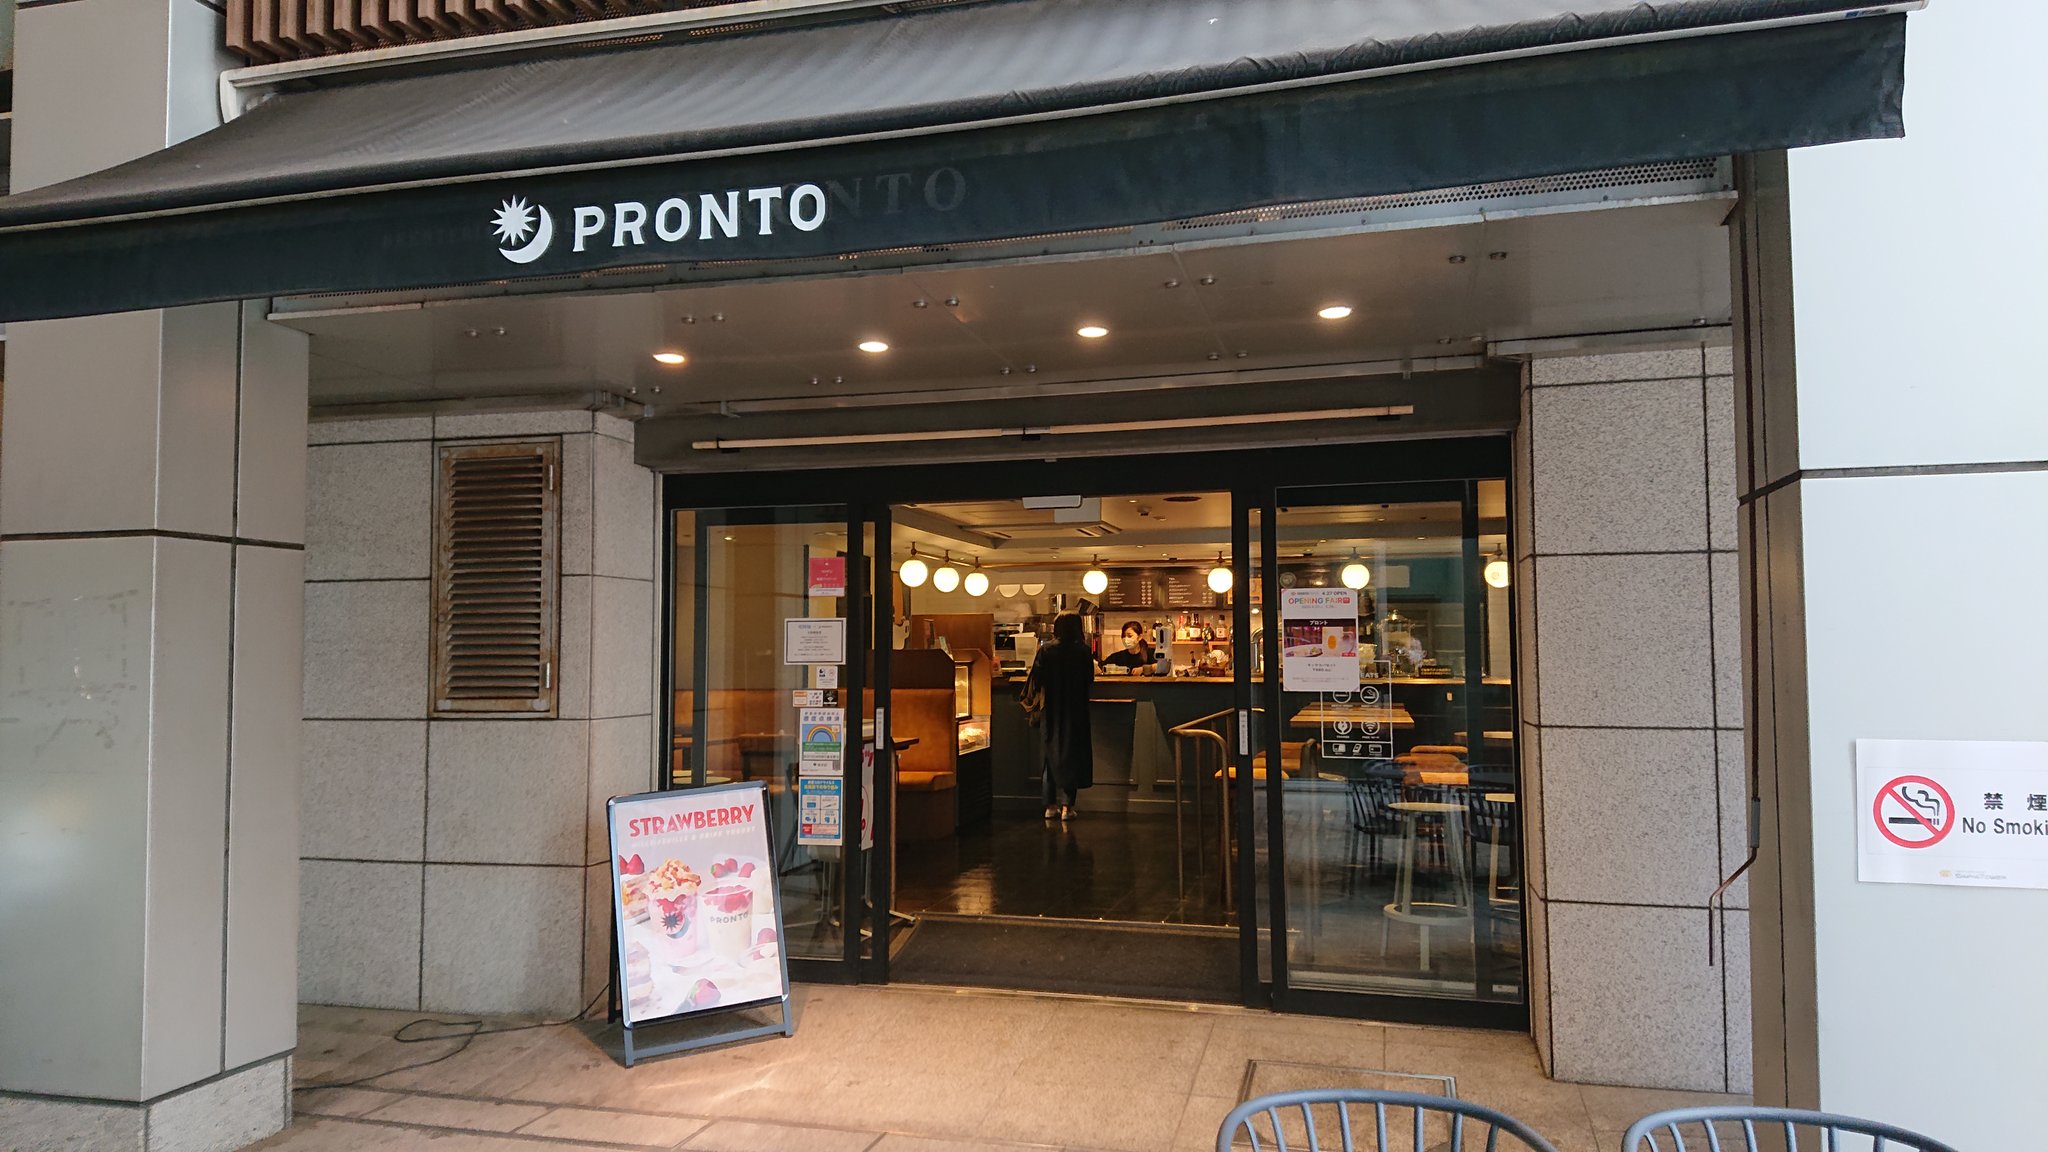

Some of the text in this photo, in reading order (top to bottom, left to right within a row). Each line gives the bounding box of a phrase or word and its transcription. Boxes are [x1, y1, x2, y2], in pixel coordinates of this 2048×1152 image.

[572, 183, 826, 252] PRONTO
[1288, 597, 1324, 605] OPENING
[1983, 792, 2048, 811] 禁煙
[629, 804, 754, 837] STRAWBERRY
[1962, 817, 1986, 834] No
[710, 911, 749, 924] PRONTO
